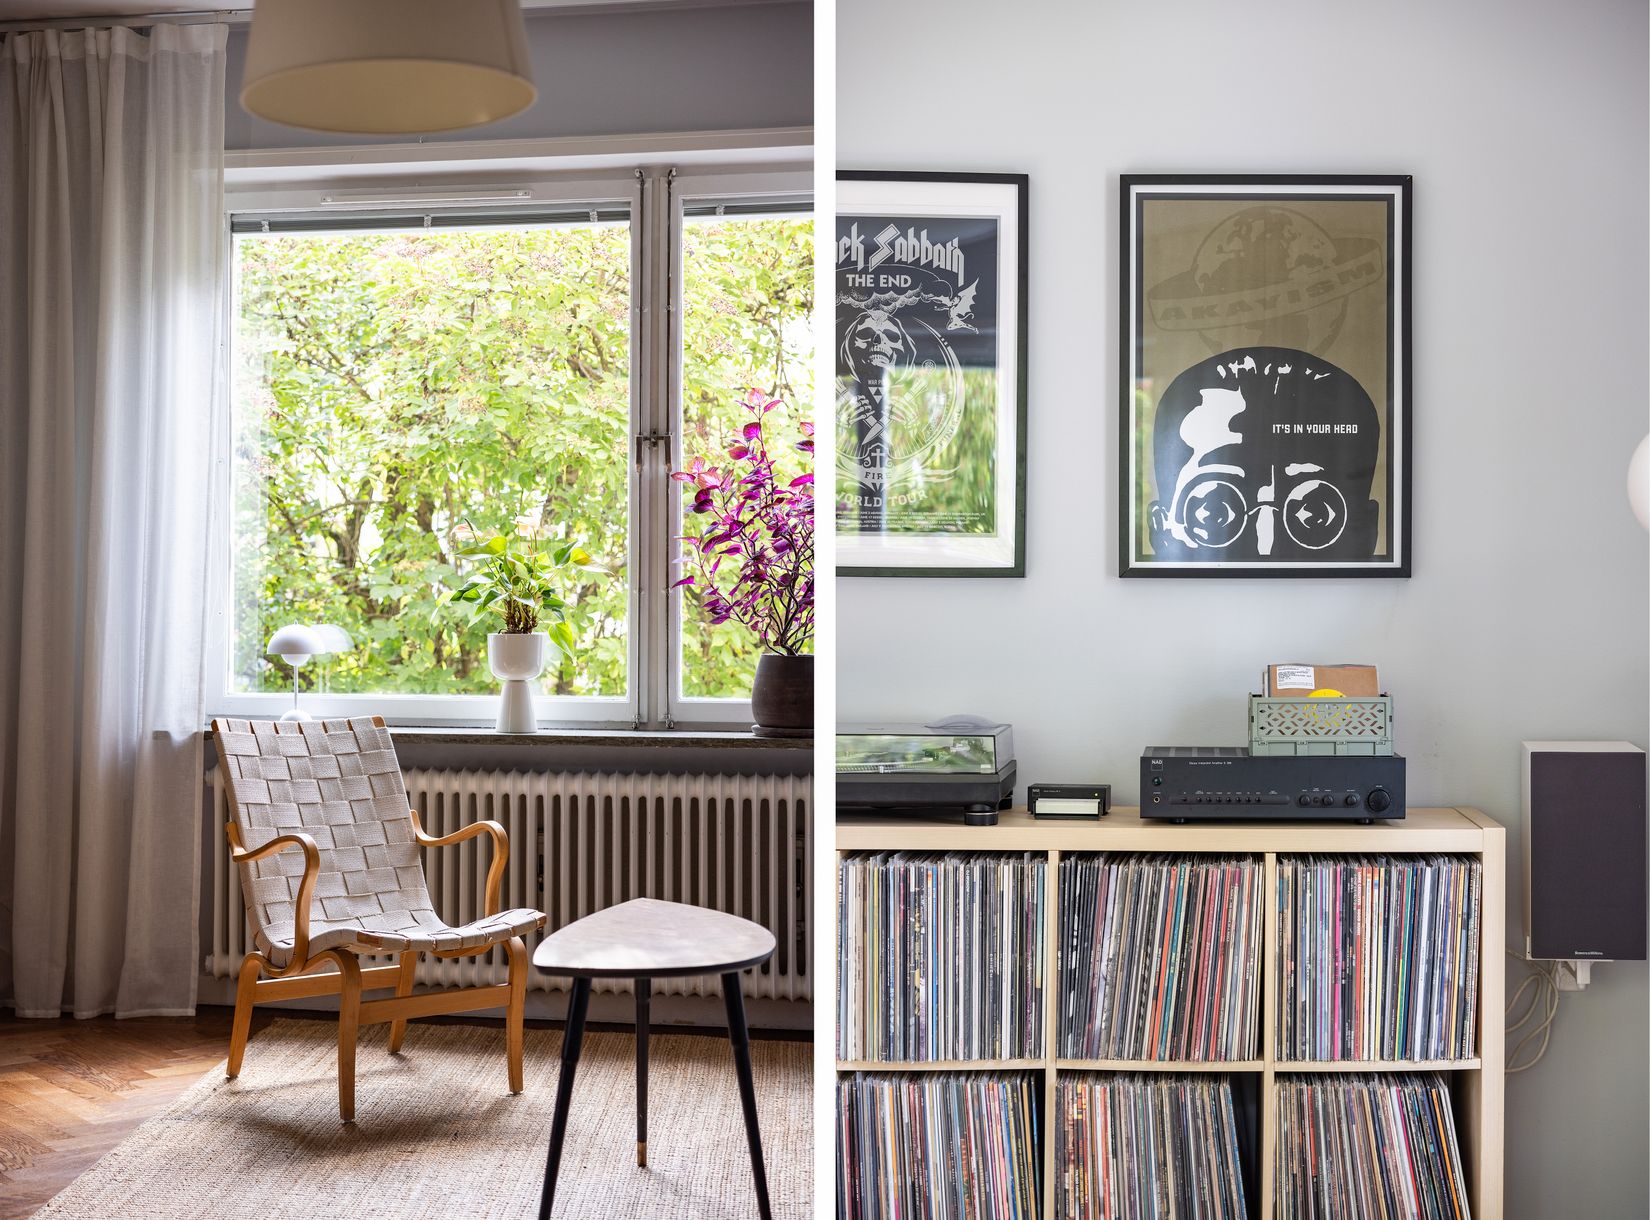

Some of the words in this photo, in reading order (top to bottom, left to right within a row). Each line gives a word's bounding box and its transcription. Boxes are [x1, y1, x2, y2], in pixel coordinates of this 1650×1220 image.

[869, 223, 965, 288] Sabbath
[846, 274, 875, 287] THE
[879, 274, 912, 288] END
[1272, 424, 1290, 434] IT'S
[1293, 424, 1303, 434] IN
[1306, 424, 1331, 434] YOUR
[1333, 424, 1358, 434] HEAD
[888, 489, 928, 507] TOUR
